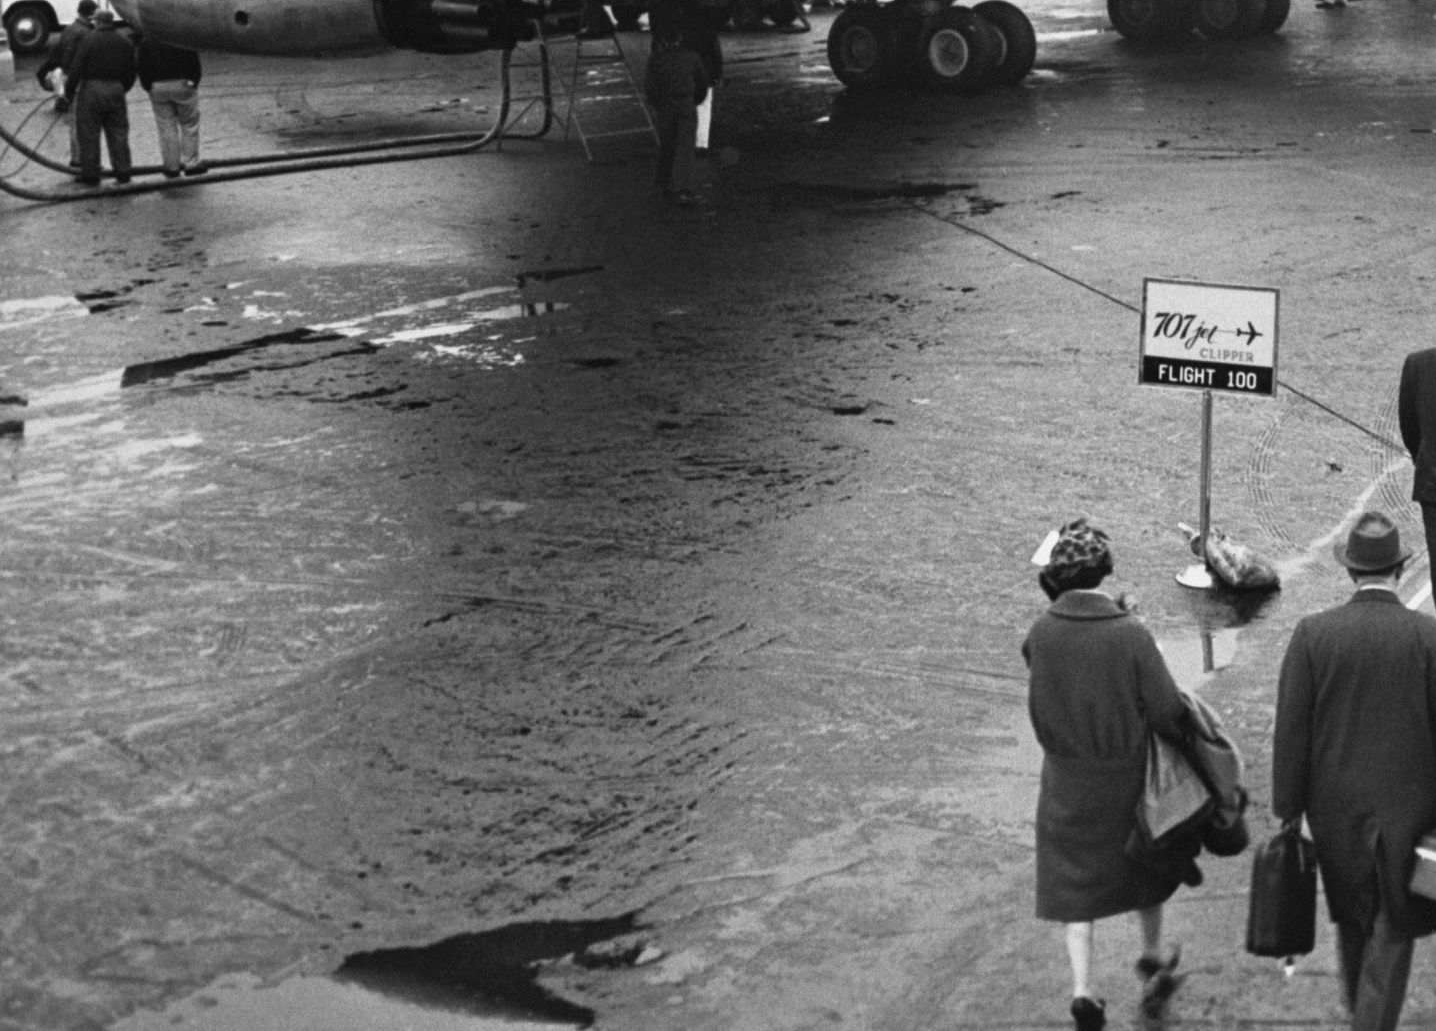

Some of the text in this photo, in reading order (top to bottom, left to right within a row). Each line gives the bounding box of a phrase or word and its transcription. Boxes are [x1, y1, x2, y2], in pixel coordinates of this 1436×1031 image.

[1152, 311, 1219, 350] 707 jet
[1199, 347, 1255, 364] CLIPPER
[1157, 363, 1258, 391] FLIGHT 100
